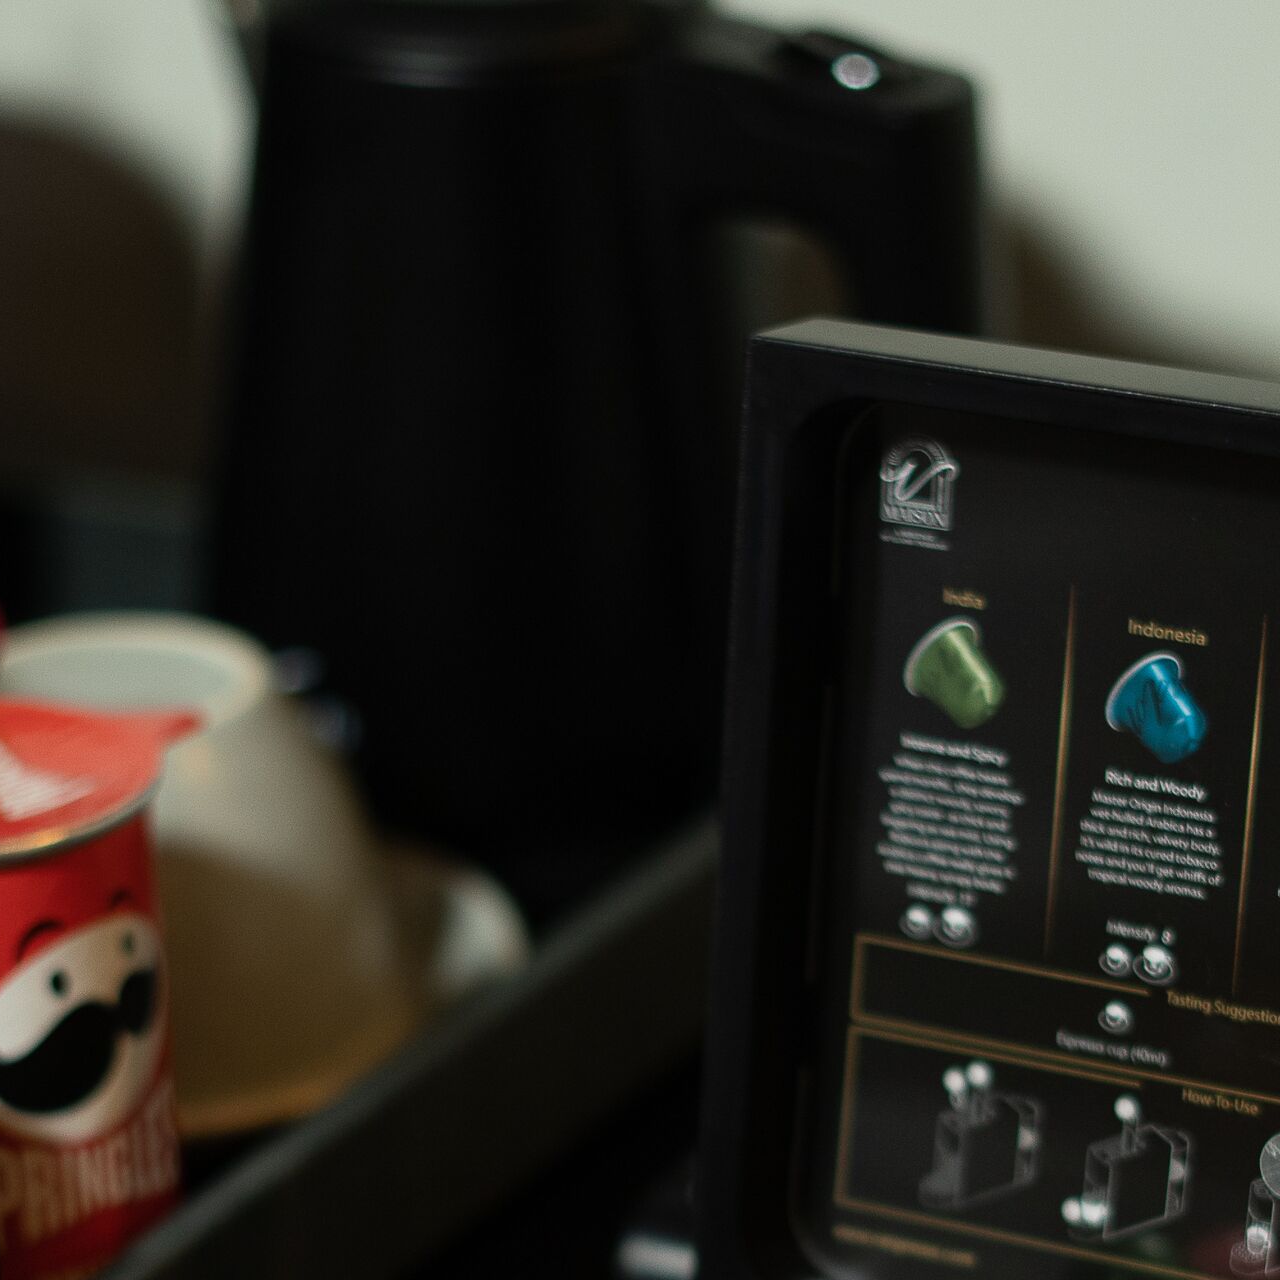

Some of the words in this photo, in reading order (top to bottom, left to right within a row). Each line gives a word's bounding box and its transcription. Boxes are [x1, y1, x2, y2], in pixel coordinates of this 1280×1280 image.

[1128, 619, 1207, 646] Indonesia
[1105, 771, 1132, 788] Rich
[1134, 778, 1159, 792] and
[1160, 780, 1206, 802] Woody
[1092, 791, 1127, 807] Master
[1129, 797, 1162, 814] Origin
[1164, 803, 1213, 822] Indonesia
[1168, 990, 1210, 1014] Tasting
